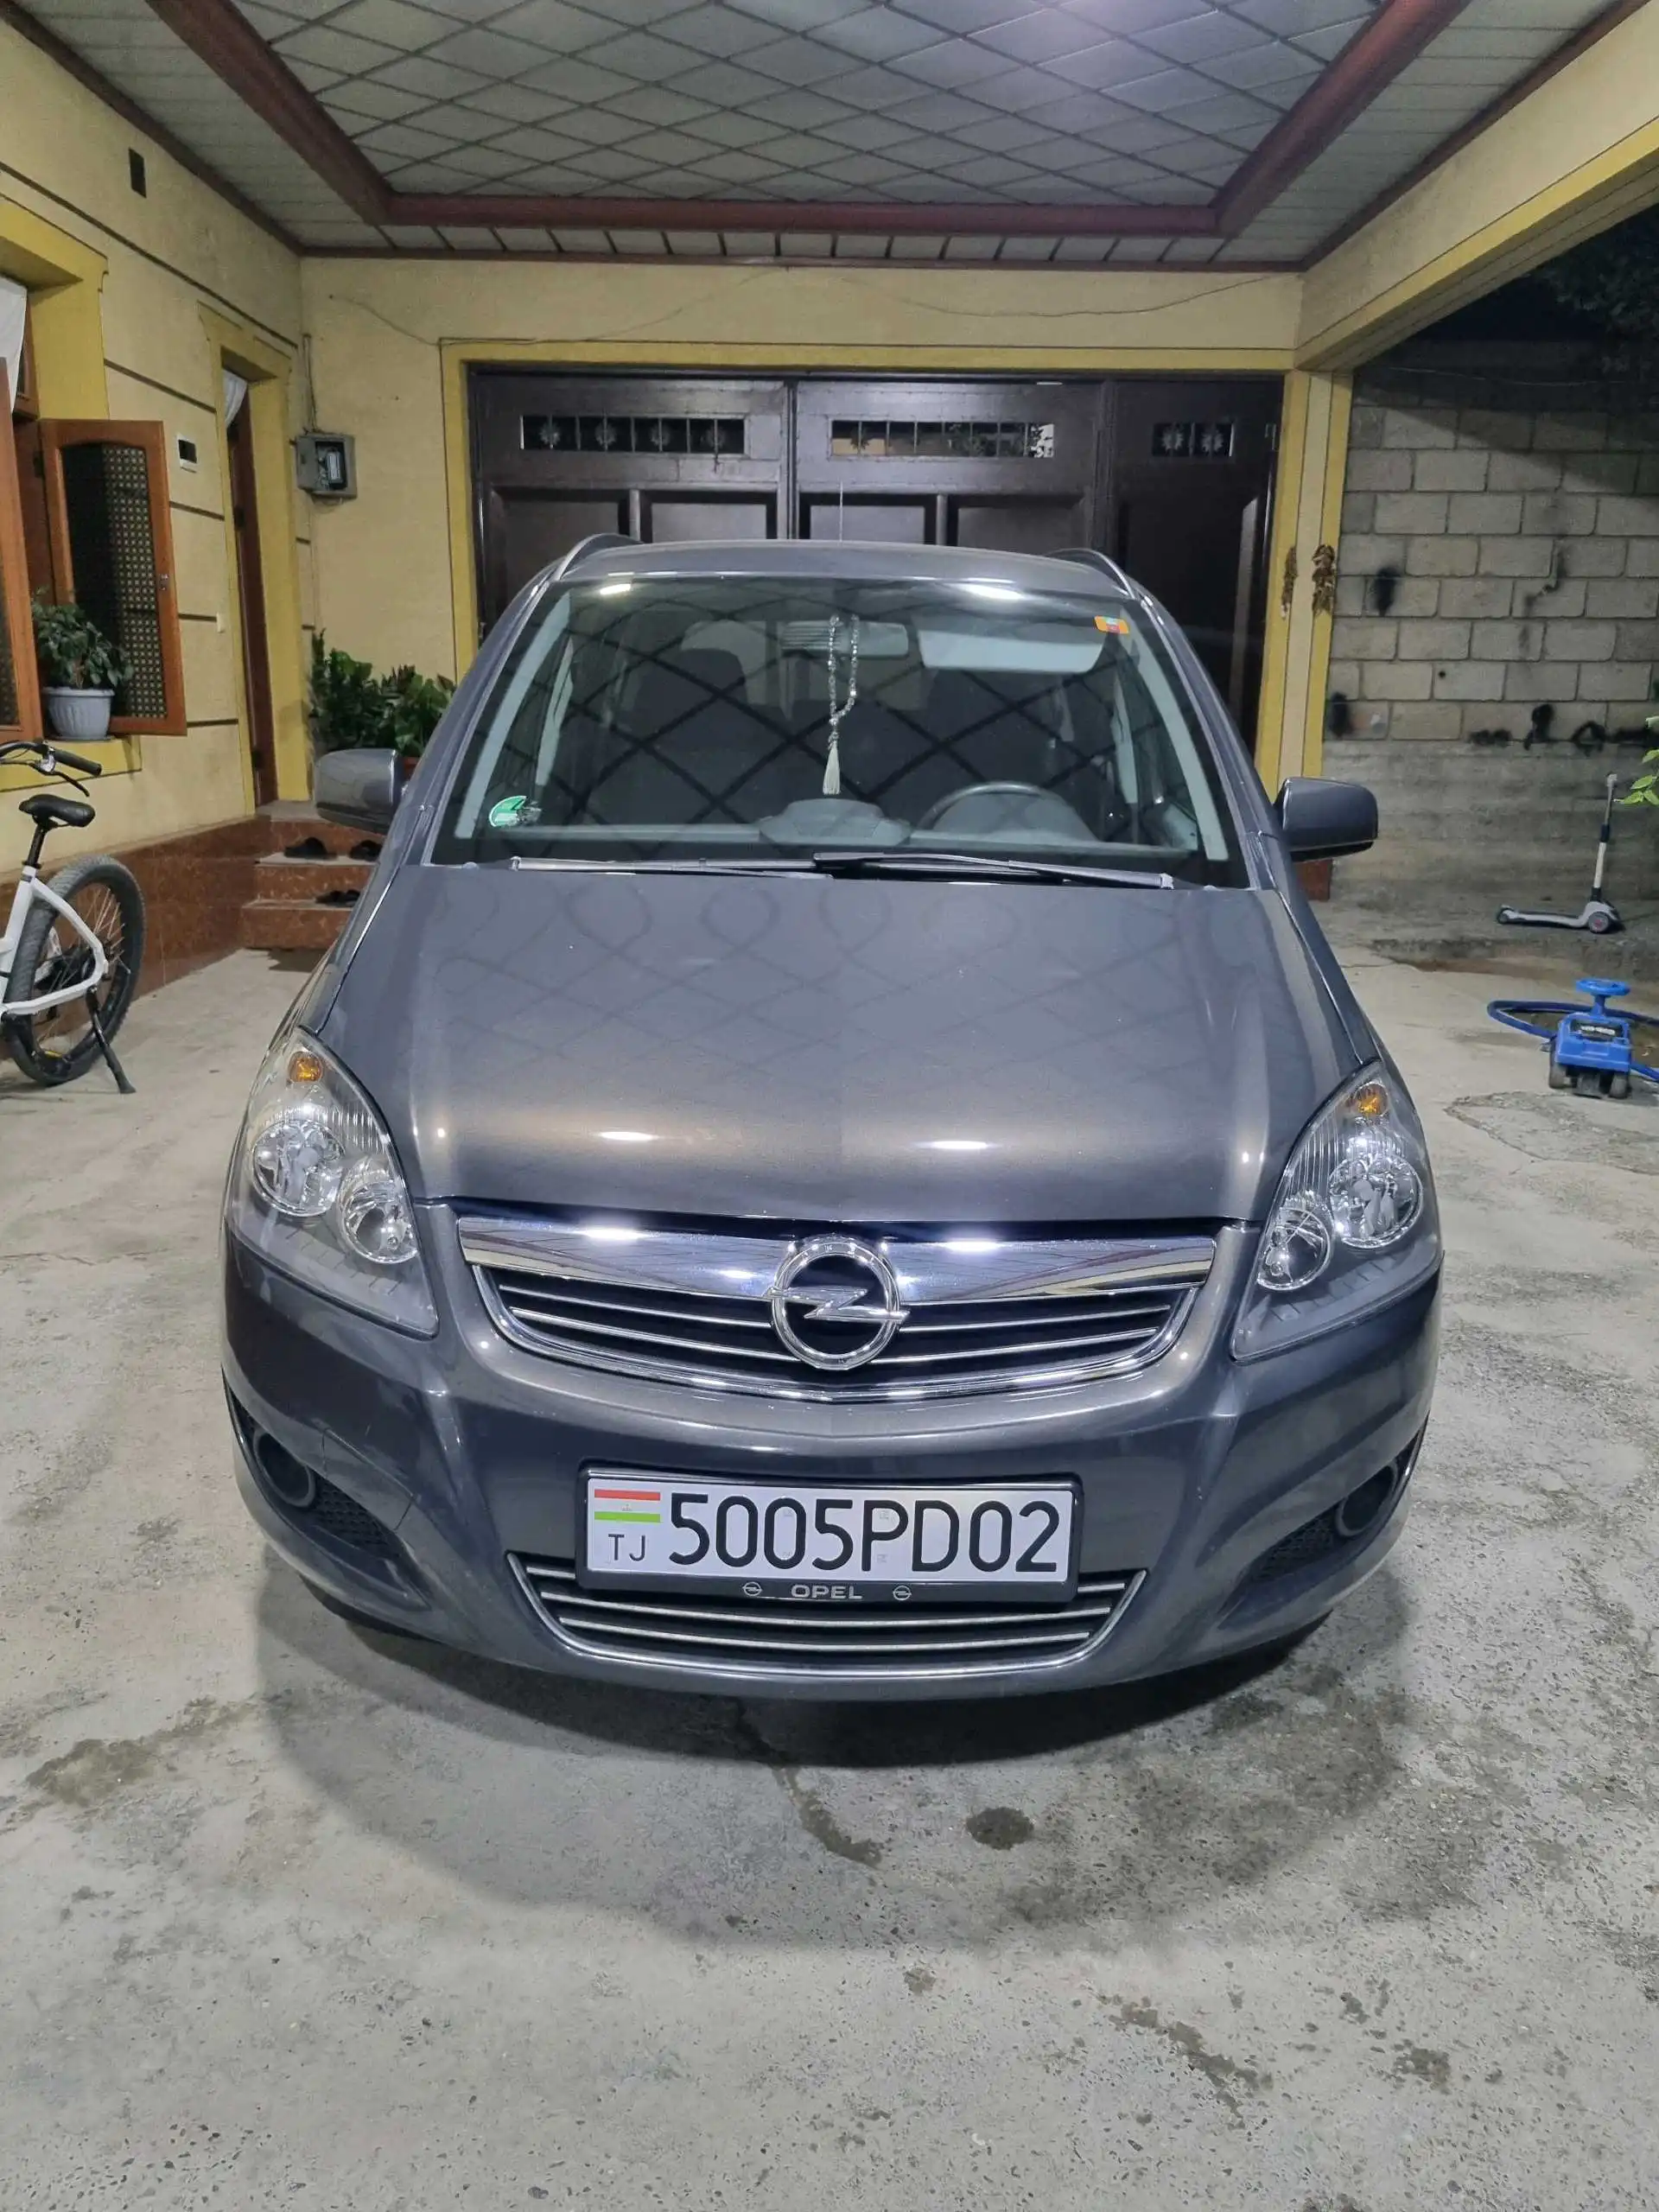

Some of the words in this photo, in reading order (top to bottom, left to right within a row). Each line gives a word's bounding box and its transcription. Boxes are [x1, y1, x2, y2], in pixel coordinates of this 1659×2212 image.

[608, 1533, 646, 1561] TJ
[669, 1492, 1060, 1573] 5005PD02
[791, 1584, 863, 1599] OPEL
